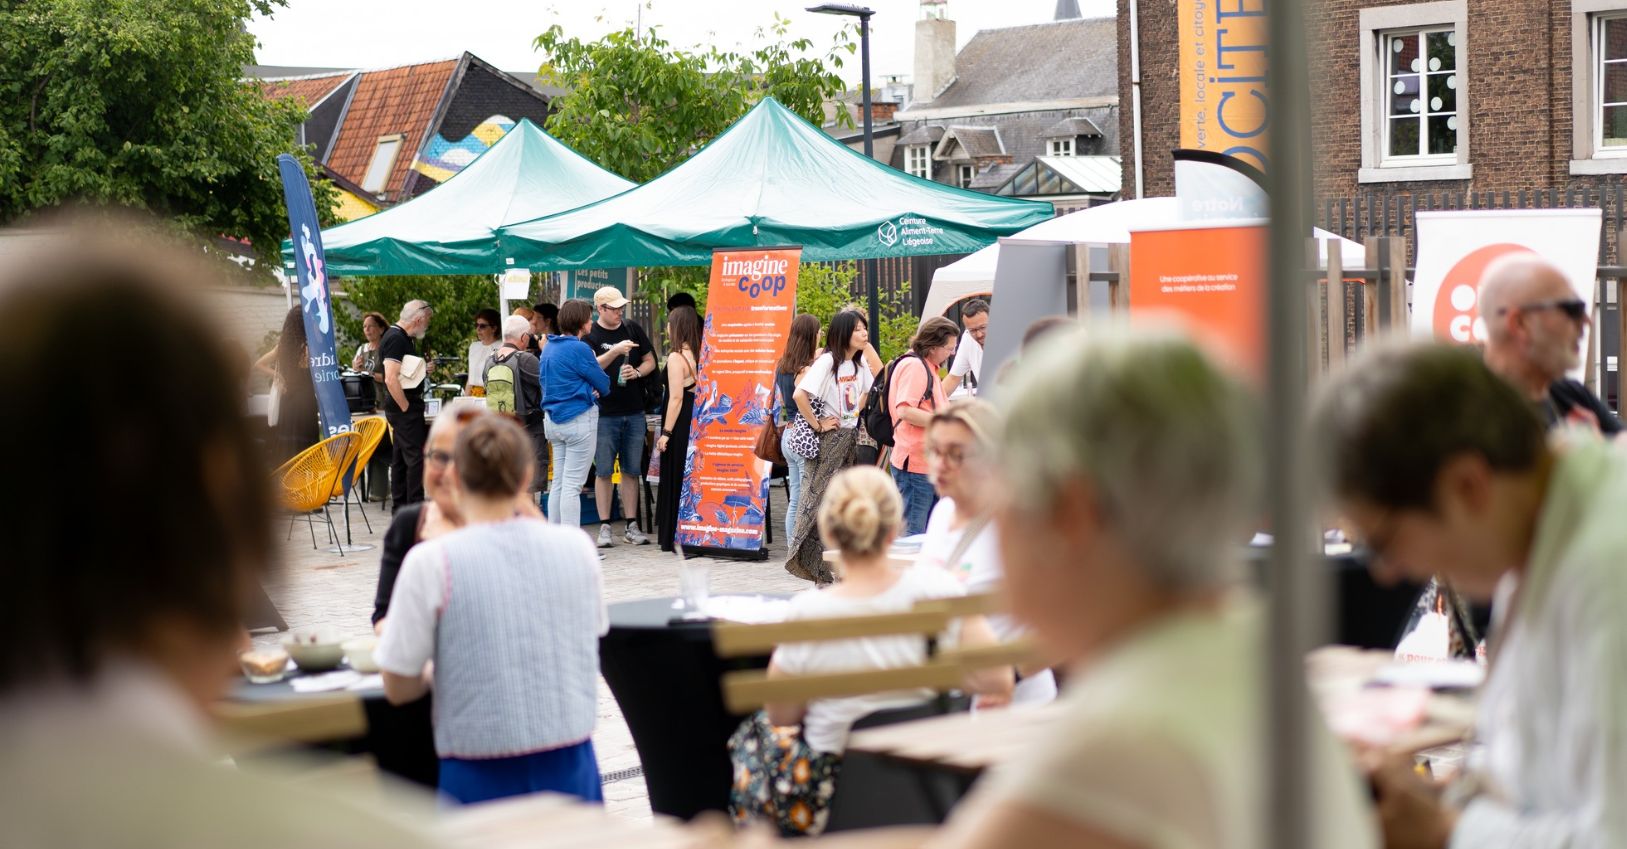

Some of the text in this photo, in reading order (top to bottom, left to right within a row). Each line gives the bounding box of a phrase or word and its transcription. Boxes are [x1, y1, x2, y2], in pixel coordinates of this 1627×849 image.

[1195, 0, 1206, 38] citoy
[1194, 42, 1205, 56] et
[1194, 60, 1205, 103] locale
[899, 217, 926, 225] Ceinture
[589, 268, 608, 282] petits
[721, 255, 788, 281] imagine
[1159, 275, 1172, 283] Une
[1172, 274, 1207, 284] coopérative
[1216, 273, 1238, 281] service
[738, 275, 786, 298] coop
[1173, 284, 1196, 292] métiers
[1210, 283, 1236, 291] création
